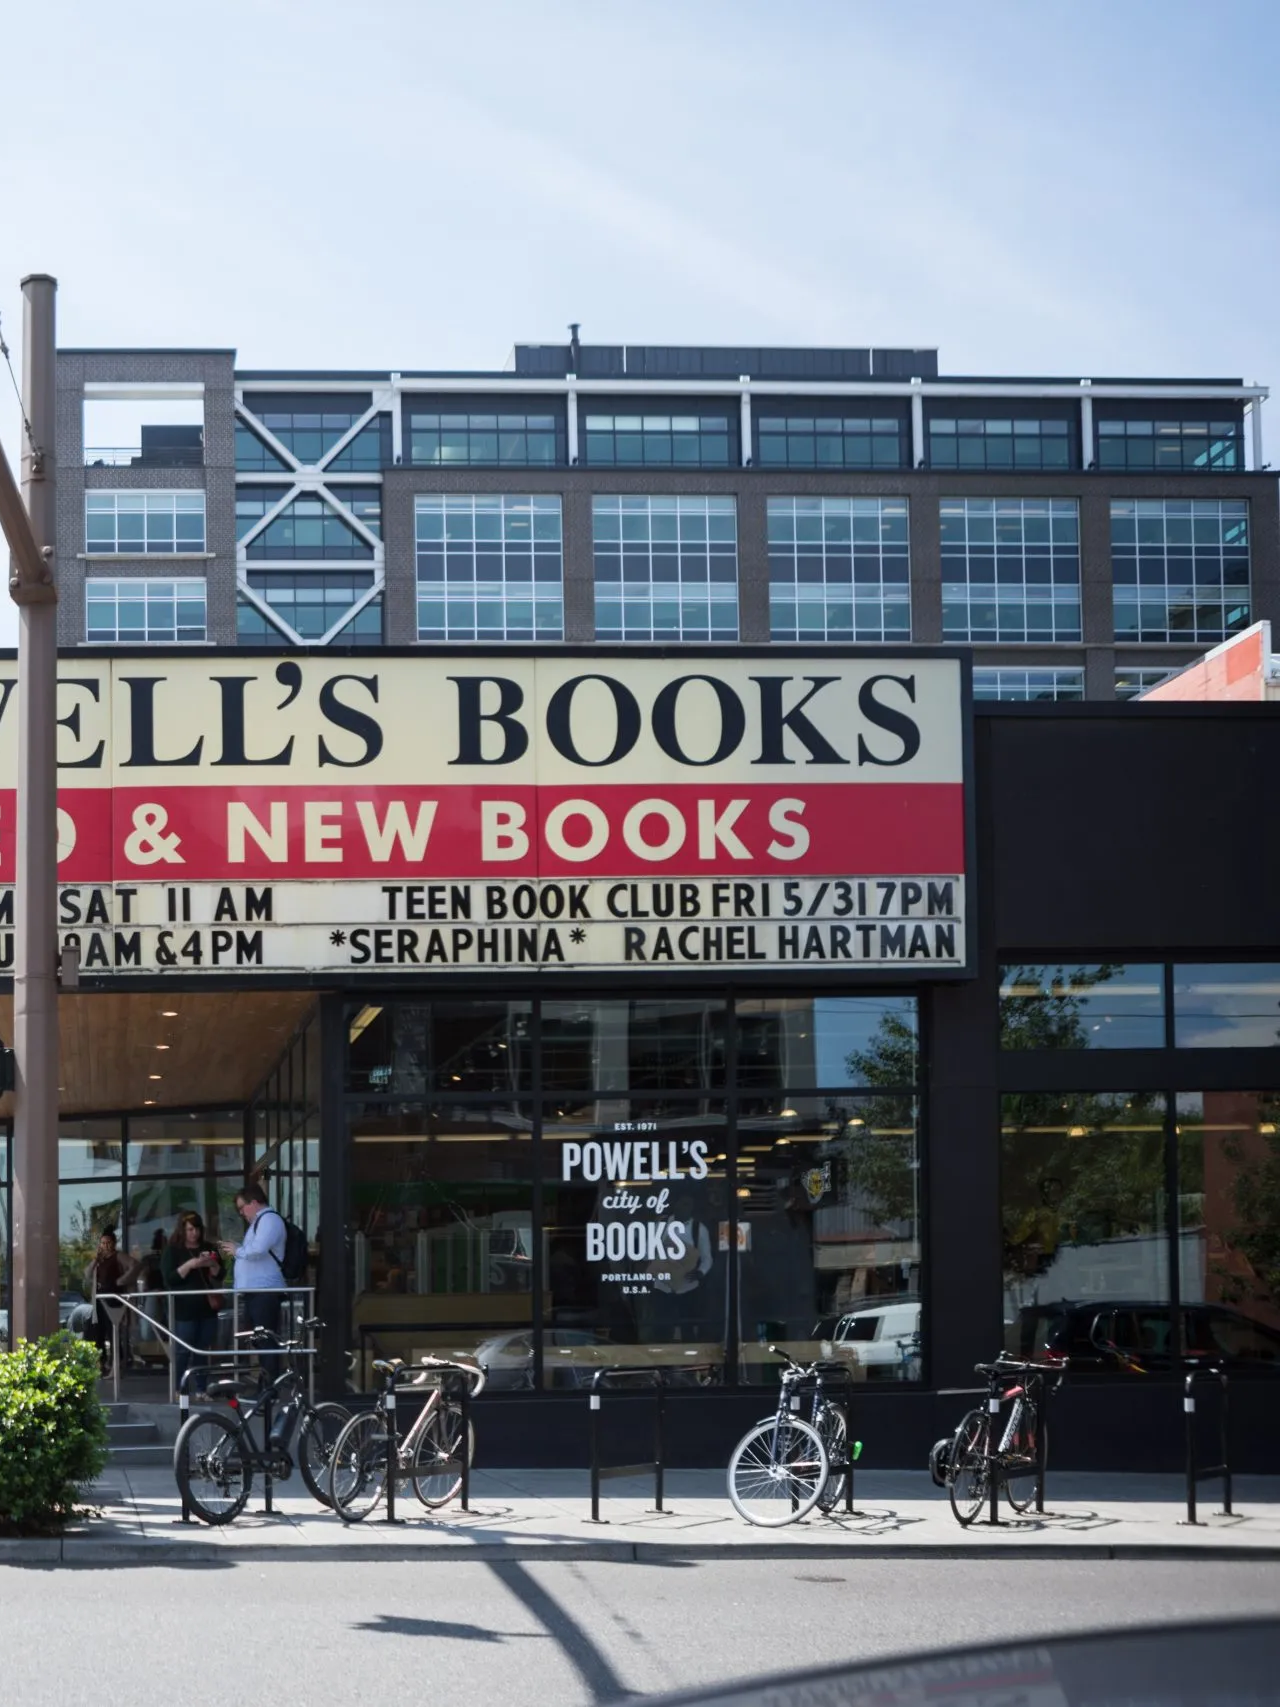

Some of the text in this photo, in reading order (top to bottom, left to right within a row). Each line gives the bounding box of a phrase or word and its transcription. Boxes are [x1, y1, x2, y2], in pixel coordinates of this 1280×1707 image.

[446, 673, 922, 767] BOOKS
[123, 802, 186, 866] &
[227, 799, 439, 864] NEW
[480, 797, 811, 863] BOOKS
[59, 888, 138, 924] SAT
[213, 886, 273, 922] AM
[381, 885, 472, 921] TEEN
[486, 884, 592, 919] BOOK
[607, 883, 701, 918] CLUB
[712, 882, 770, 918] FRI
[623, 925, 767, 962] RACHEL
[778, 924, 956, 960] HARTMAN
[614, 1122, 657, 1132] EST. 1971
[562, 1140, 709, 1182] POWELL'S
[602, 1187, 670, 1215] city of
[585, 1220, 687, 1262] BOOKS
[601, 1272, 671, 1282] PORTLAND, OR
[622, 1286, 651, 1294] U.S.A.
